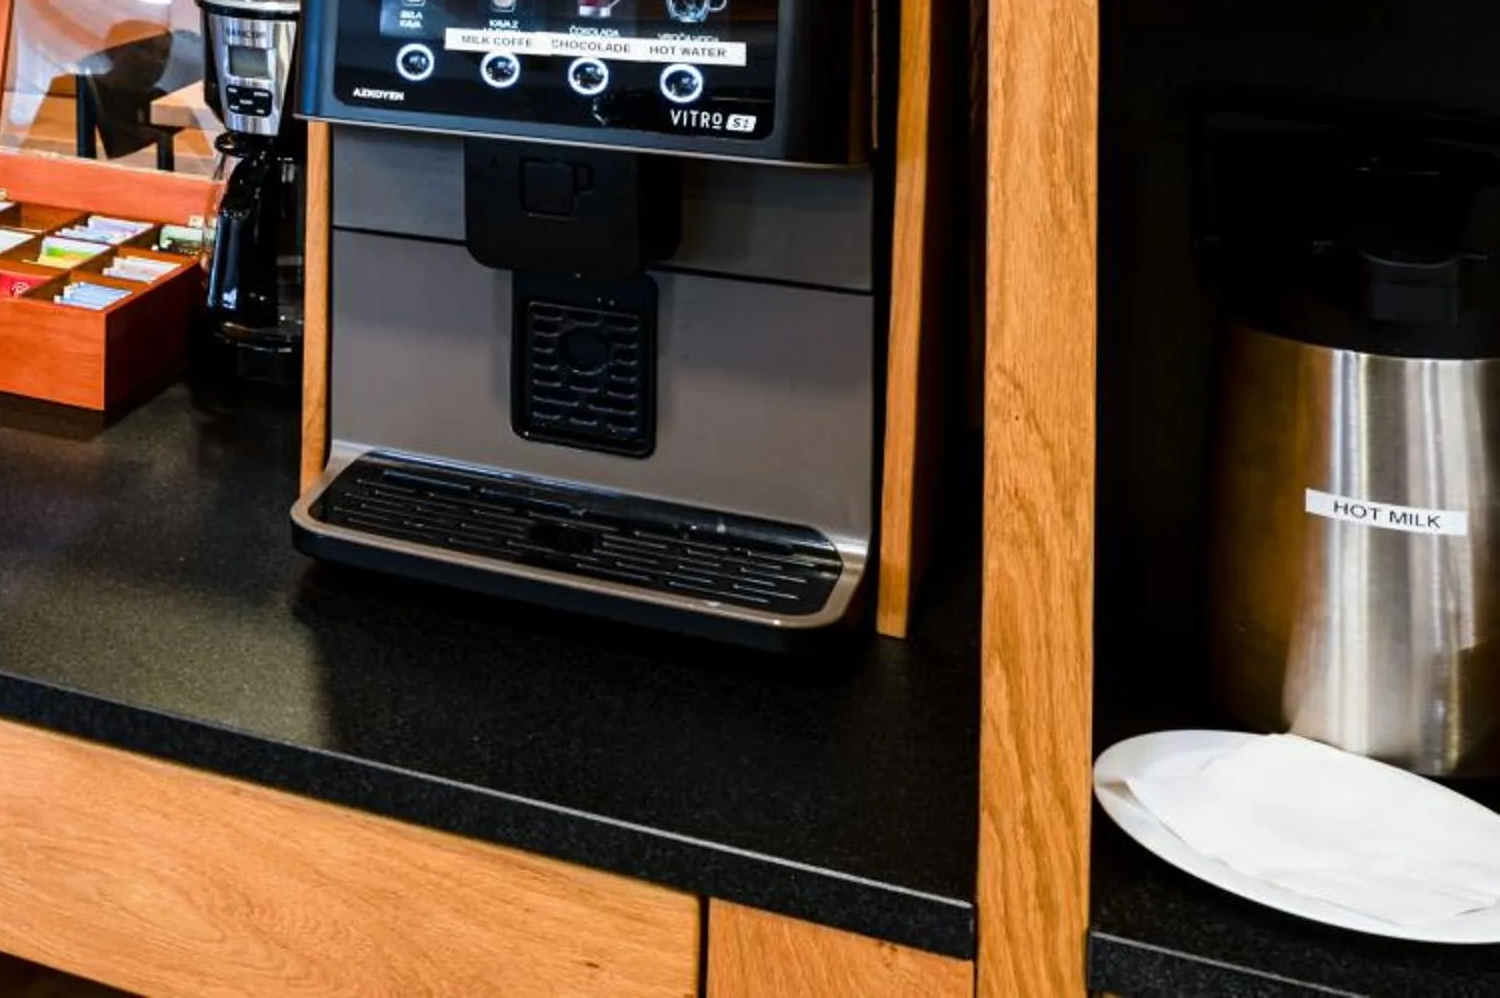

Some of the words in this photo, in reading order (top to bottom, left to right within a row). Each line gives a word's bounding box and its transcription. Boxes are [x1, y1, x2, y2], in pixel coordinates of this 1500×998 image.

[461, 35, 490, 46] MILK
[493, 36, 533, 49] COFFE
[551, 39, 631, 54] CHOCOLADE
[650, 45, 676, 56] HOT
[681, 47, 727, 59] WATER
[670, 109, 723, 130] VITRO
[1333, 500, 1382, 521] HOT
[1389, 510, 1442, 529] MILK
